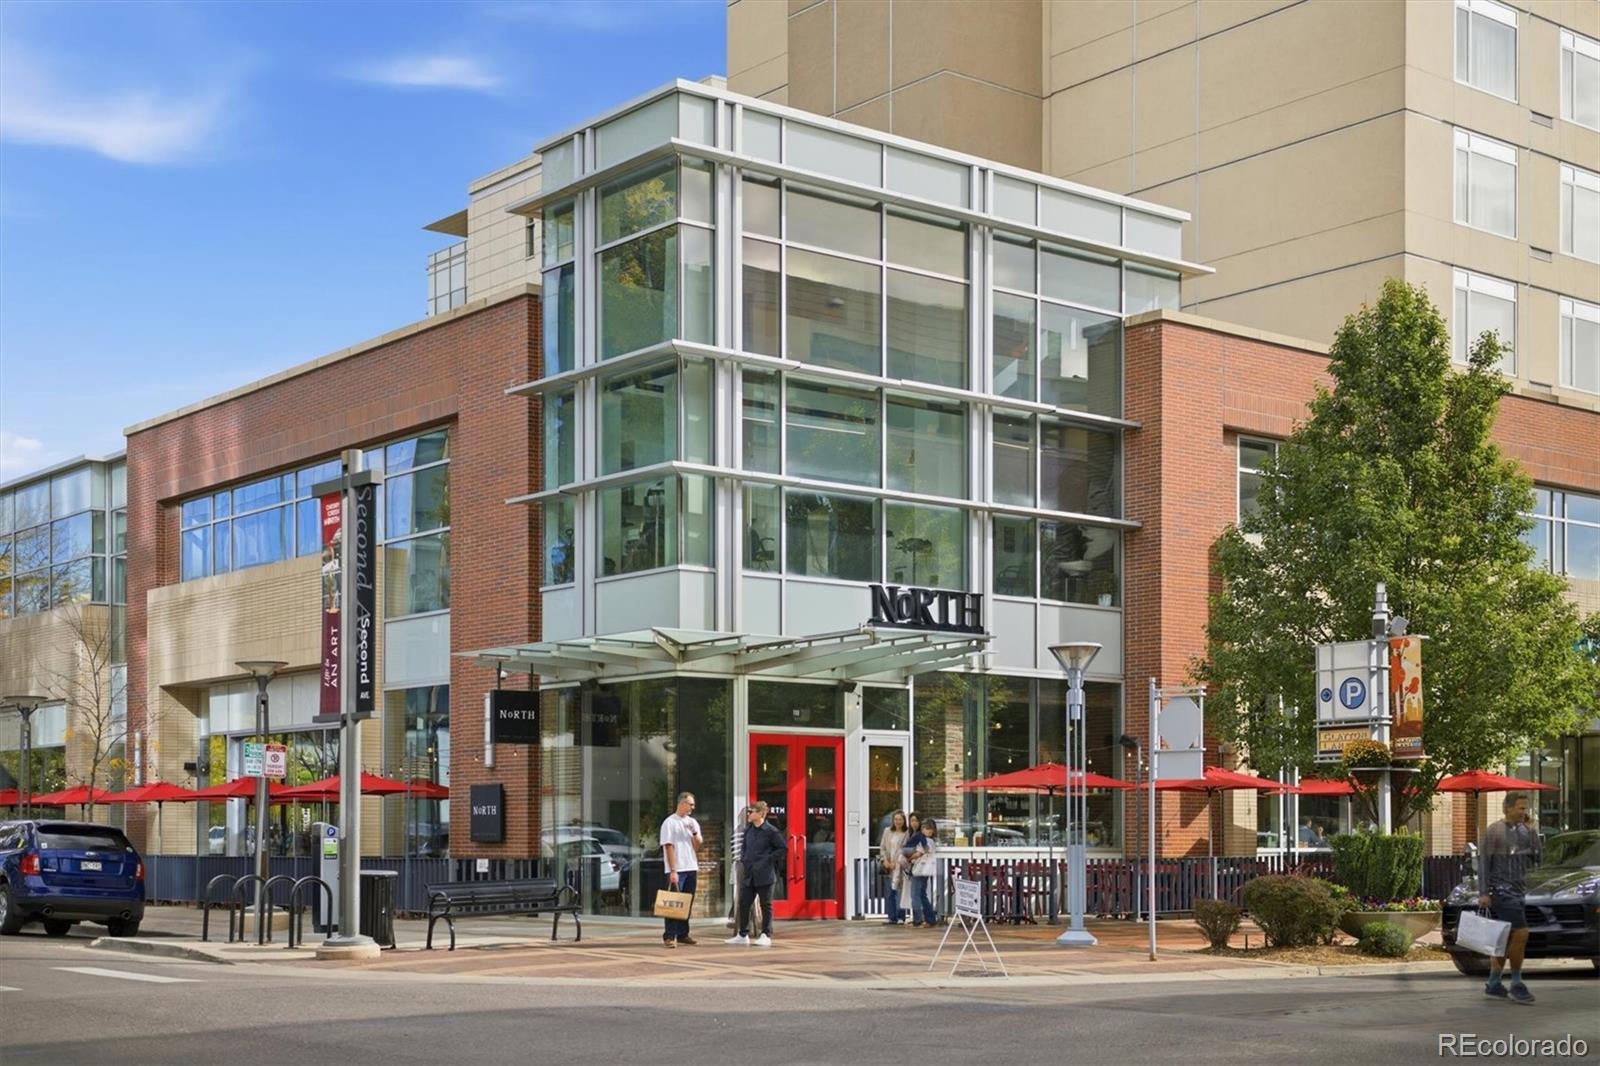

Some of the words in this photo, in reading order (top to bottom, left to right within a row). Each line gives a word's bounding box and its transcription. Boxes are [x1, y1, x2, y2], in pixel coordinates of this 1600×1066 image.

[360, 618, 370, 684] Second
[331, 664, 338, 688] AN
[1346, 682, 1362, 706] P
[663, 899, 684, 909] YETI
